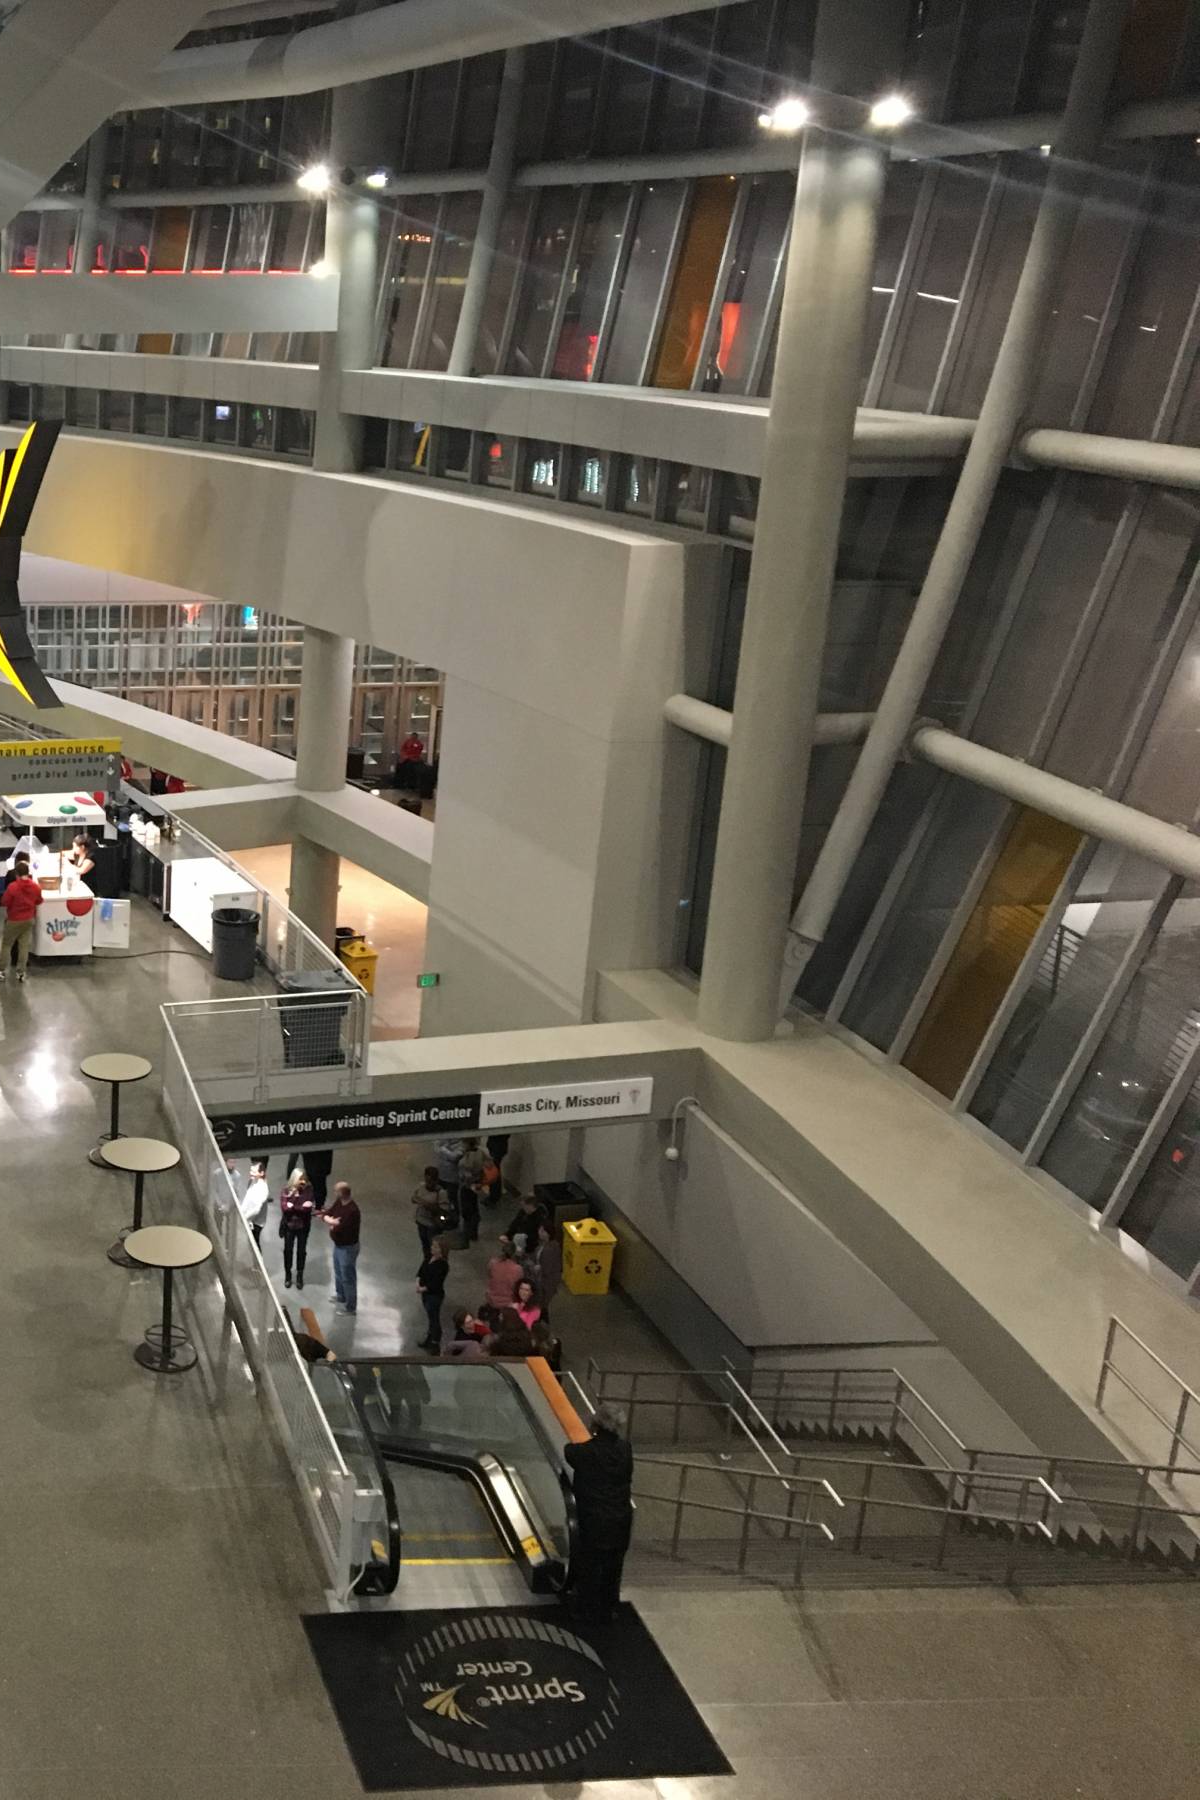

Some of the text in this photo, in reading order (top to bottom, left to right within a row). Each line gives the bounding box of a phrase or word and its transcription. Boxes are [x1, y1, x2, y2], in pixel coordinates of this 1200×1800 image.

[32, 745, 104, 756] concourse
[486, 1100, 532, 1116] Kansas
[565, 1092, 621, 1109] Missouri
[245, 1121, 285, 1137] Thank
[289, 1121, 312, 1136] you
[315, 1118, 334, 1131] for
[337, 1113, 385, 1129] visiting
[388, 1109, 427, 1127] Sprint
[430, 1107, 472, 1121] Center
[456, 1660, 533, 1678] Center
